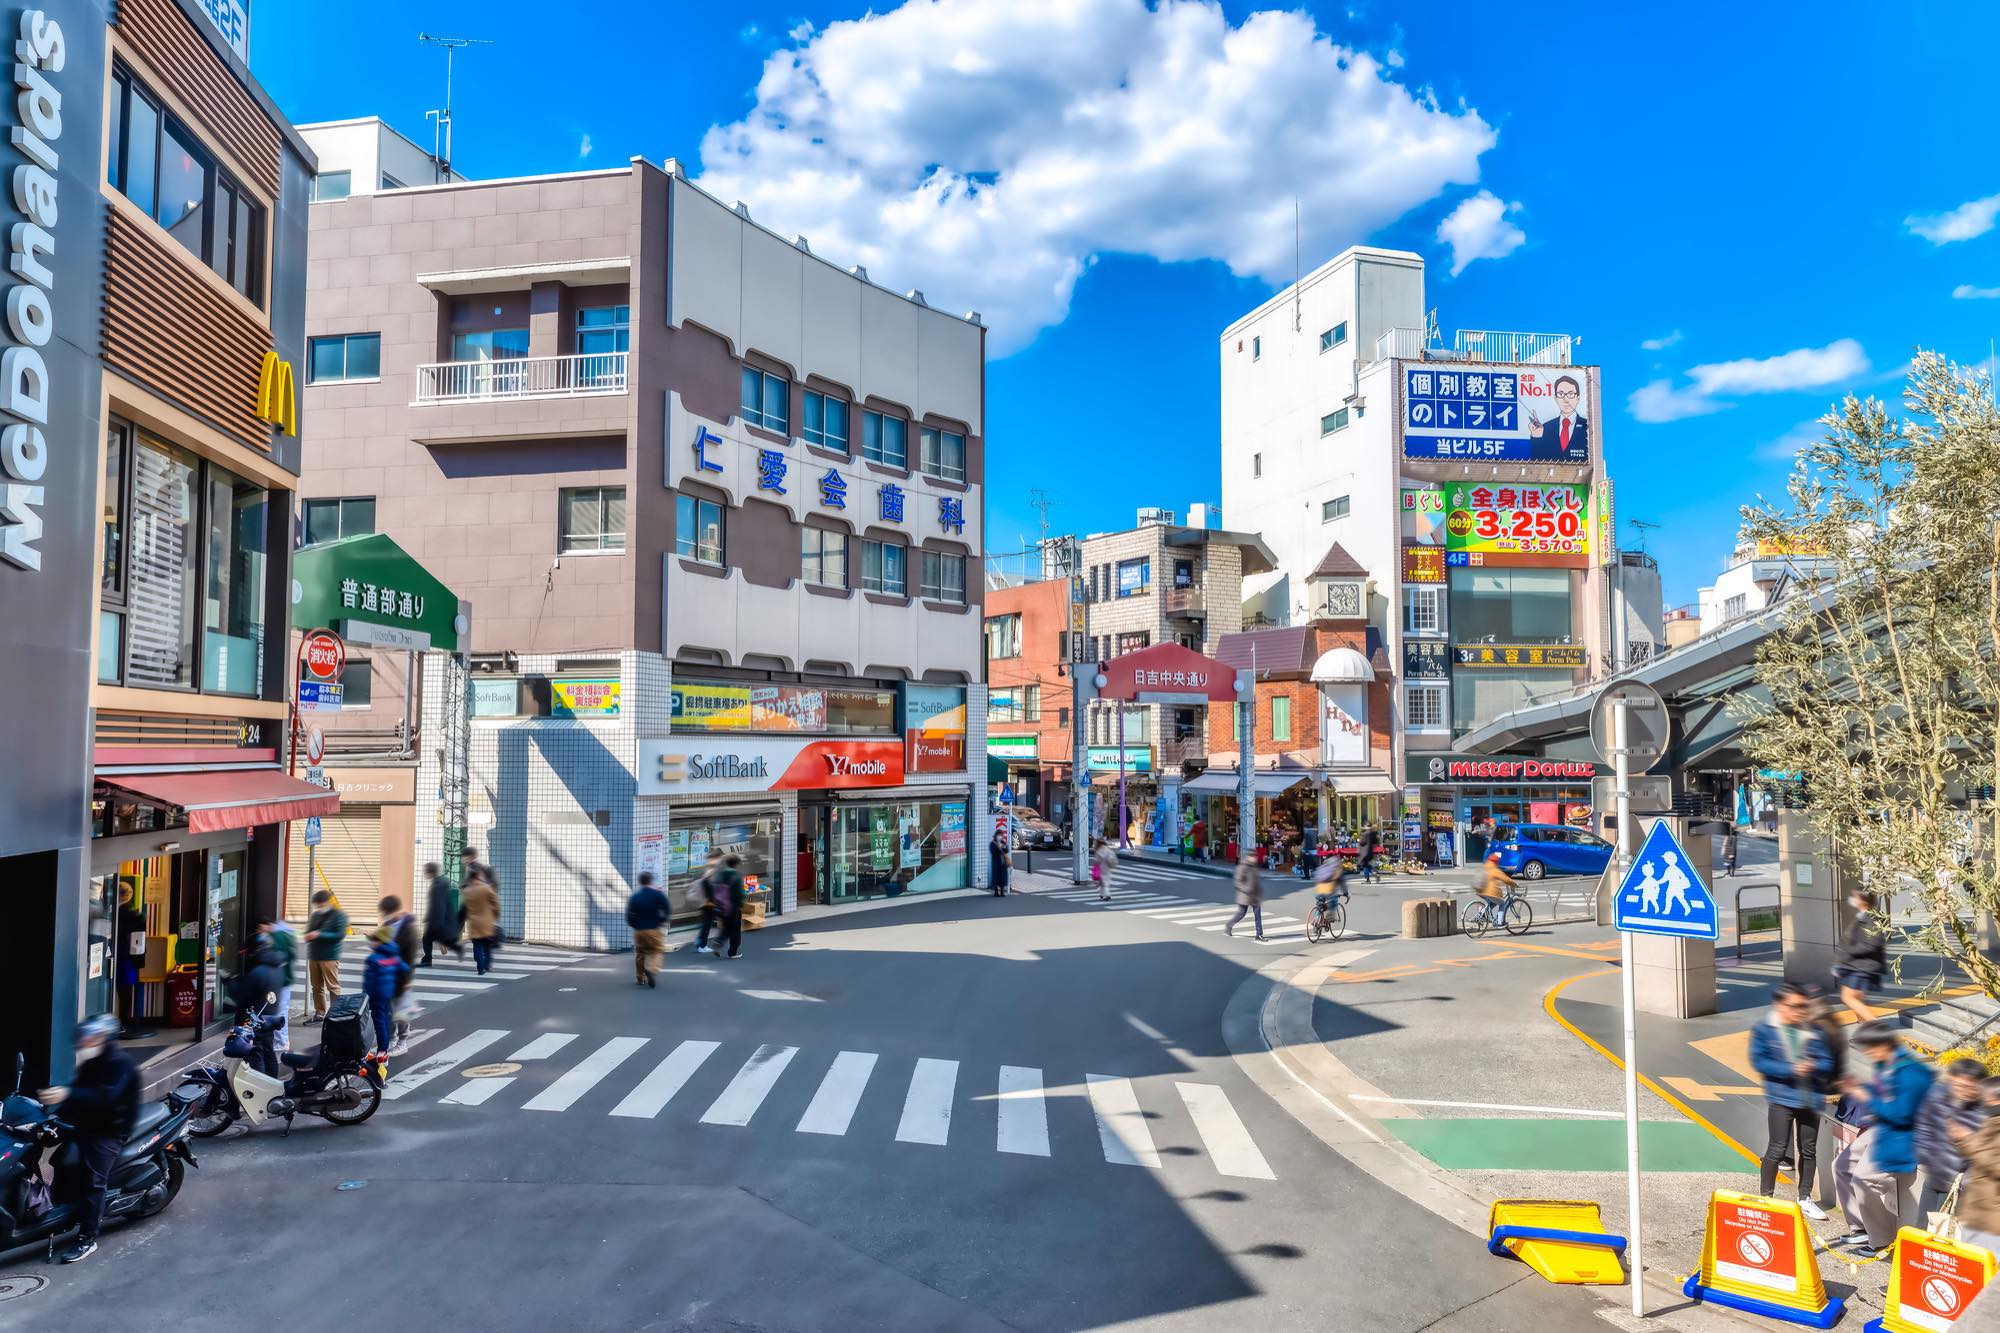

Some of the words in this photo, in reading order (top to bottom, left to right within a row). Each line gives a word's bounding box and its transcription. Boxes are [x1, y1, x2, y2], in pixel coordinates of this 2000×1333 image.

[0, 9, 65, 571] McDonald's
[1411, 373, 1515, 399] 個別教室
[1520, 373, 1535, 383] 全国
[1520, 383, 1553, 397] No.1
[1412, 403, 1513, 427] のトライ
[1436, 438, 1505, 456] 当ビル5F
[694, 424, 966, 535] 仁愛会歯科
[1404, 494, 1442, 510] ほぐし
[1471, 487, 1582, 511] 全身ほぐし
[1448, 518, 1471, 529] 60分
[1448, 553, 1466, 566] 4F
[341, 577, 424, 620] 普通部通り
[310, 647, 336, 665] 消火栓
[1407, 643, 1445, 656] 美容室
[1460, 649, 1474, 662] 3F
[1481, 649, 1544, 663] 美容室
[1410, 655, 1433, 663] パーム
[1135, 669, 1208, 687] 日吉中央通り
[475, 692, 512, 702] SoftBank
[248, 725, 260, 743] 24
[692, 755, 768, 779] SoftBank
[1524, 760, 1596, 778] Donut
[337, 783, 394, 792] 日吉クリニック
[1737, 1207, 1771, 1221] 駐輪禁止
[1757, 1220, 1770, 1228] Park
[1924, 1258, 1932, 1266] Do
[1932, 1261, 1943, 1269] Not
[1943, 1264, 1957, 1273] Park
